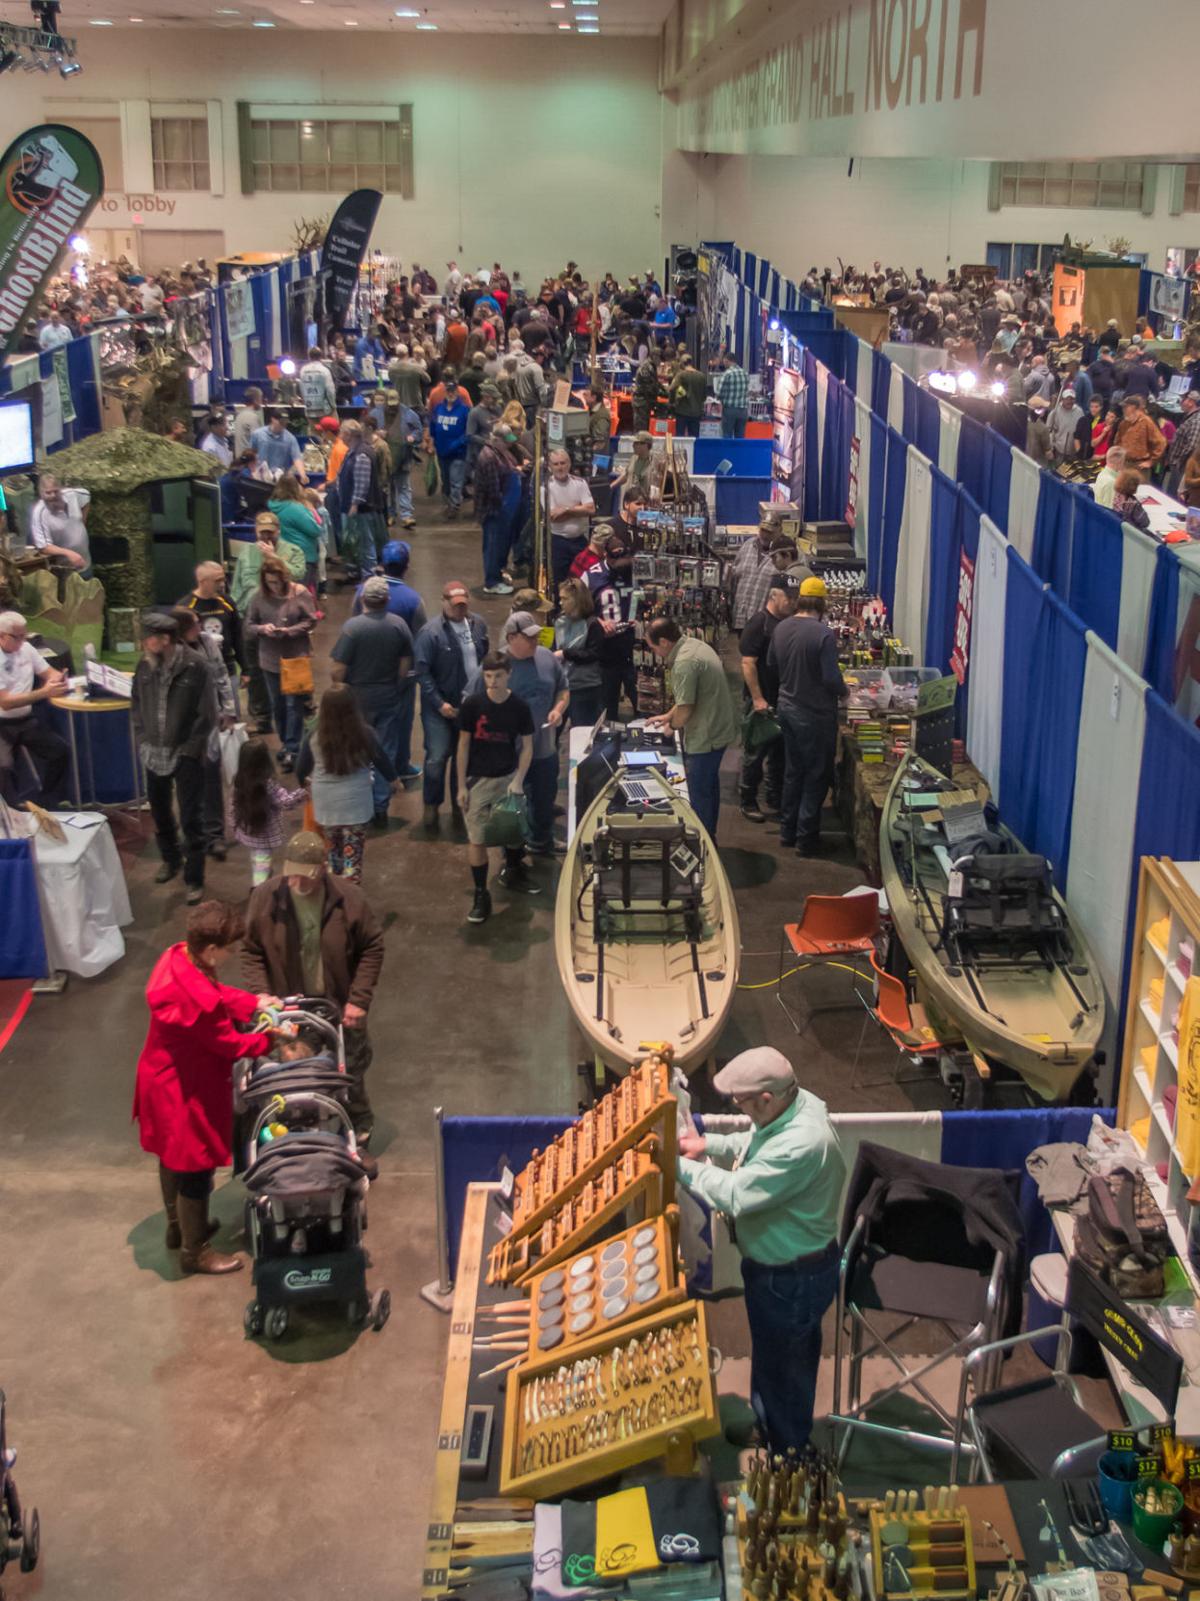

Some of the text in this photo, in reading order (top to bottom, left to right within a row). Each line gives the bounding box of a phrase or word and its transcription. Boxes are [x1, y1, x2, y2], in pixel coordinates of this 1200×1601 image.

[808, 6, 854, 119] HALL
[864, 0, 987, 112] NORTH
[101, 194, 176, 216] to lobby
[1154, 1428, 1172, 1439] $10
[1112, 1436, 1133, 1447] $10
[1138, 1461, 1158, 1472] $12
